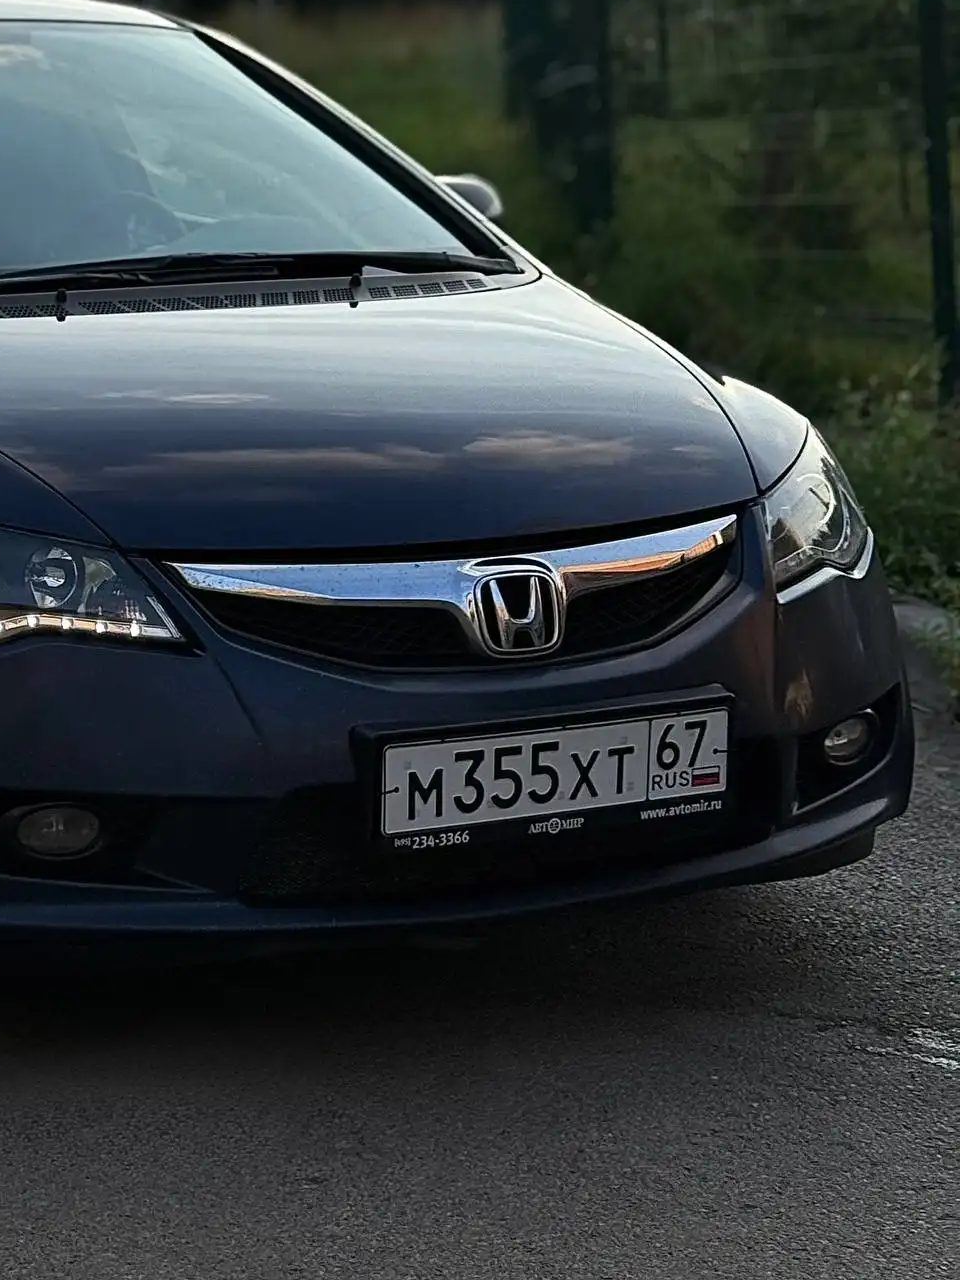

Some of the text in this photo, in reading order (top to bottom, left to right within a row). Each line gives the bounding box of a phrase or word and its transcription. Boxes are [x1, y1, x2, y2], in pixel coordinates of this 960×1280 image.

[657, 720, 707, 770] 67
[651, 770, 690, 791] RUS
[640, 800, 722, 820] www.avtomir.ru
[412, 830, 470, 849] 234-3366
